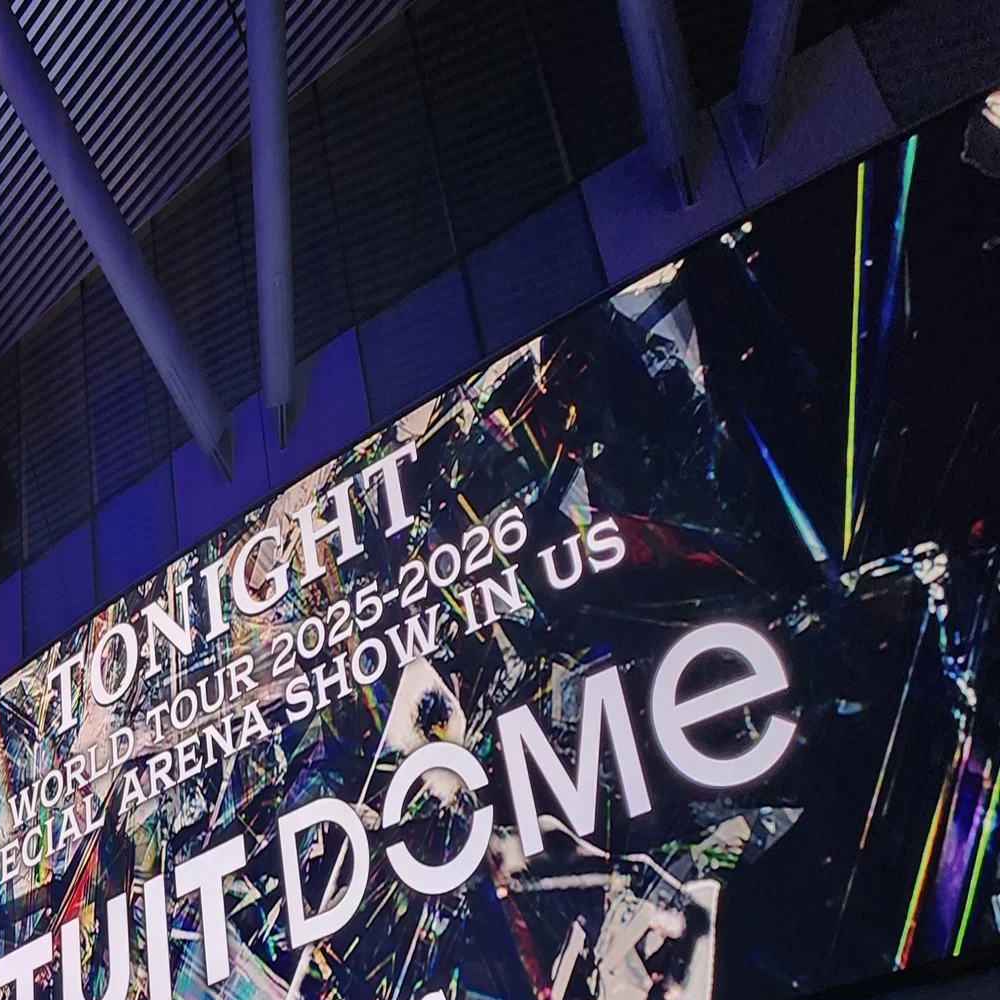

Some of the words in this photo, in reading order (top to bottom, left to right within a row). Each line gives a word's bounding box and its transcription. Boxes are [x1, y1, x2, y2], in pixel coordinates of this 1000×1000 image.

[8, 727, 135, 829] WORLD
[146, 654, 260, 745] TOUR
[271, 506, 528, 677] 2025-2026
[46, 440, 419, 737] TONIGHT
[117, 700, 273, 817] ARENA
[285, 603, 441, 723] SHOW
[457, 563, 527, 636] IN
[536, 516, 626, 590] US
